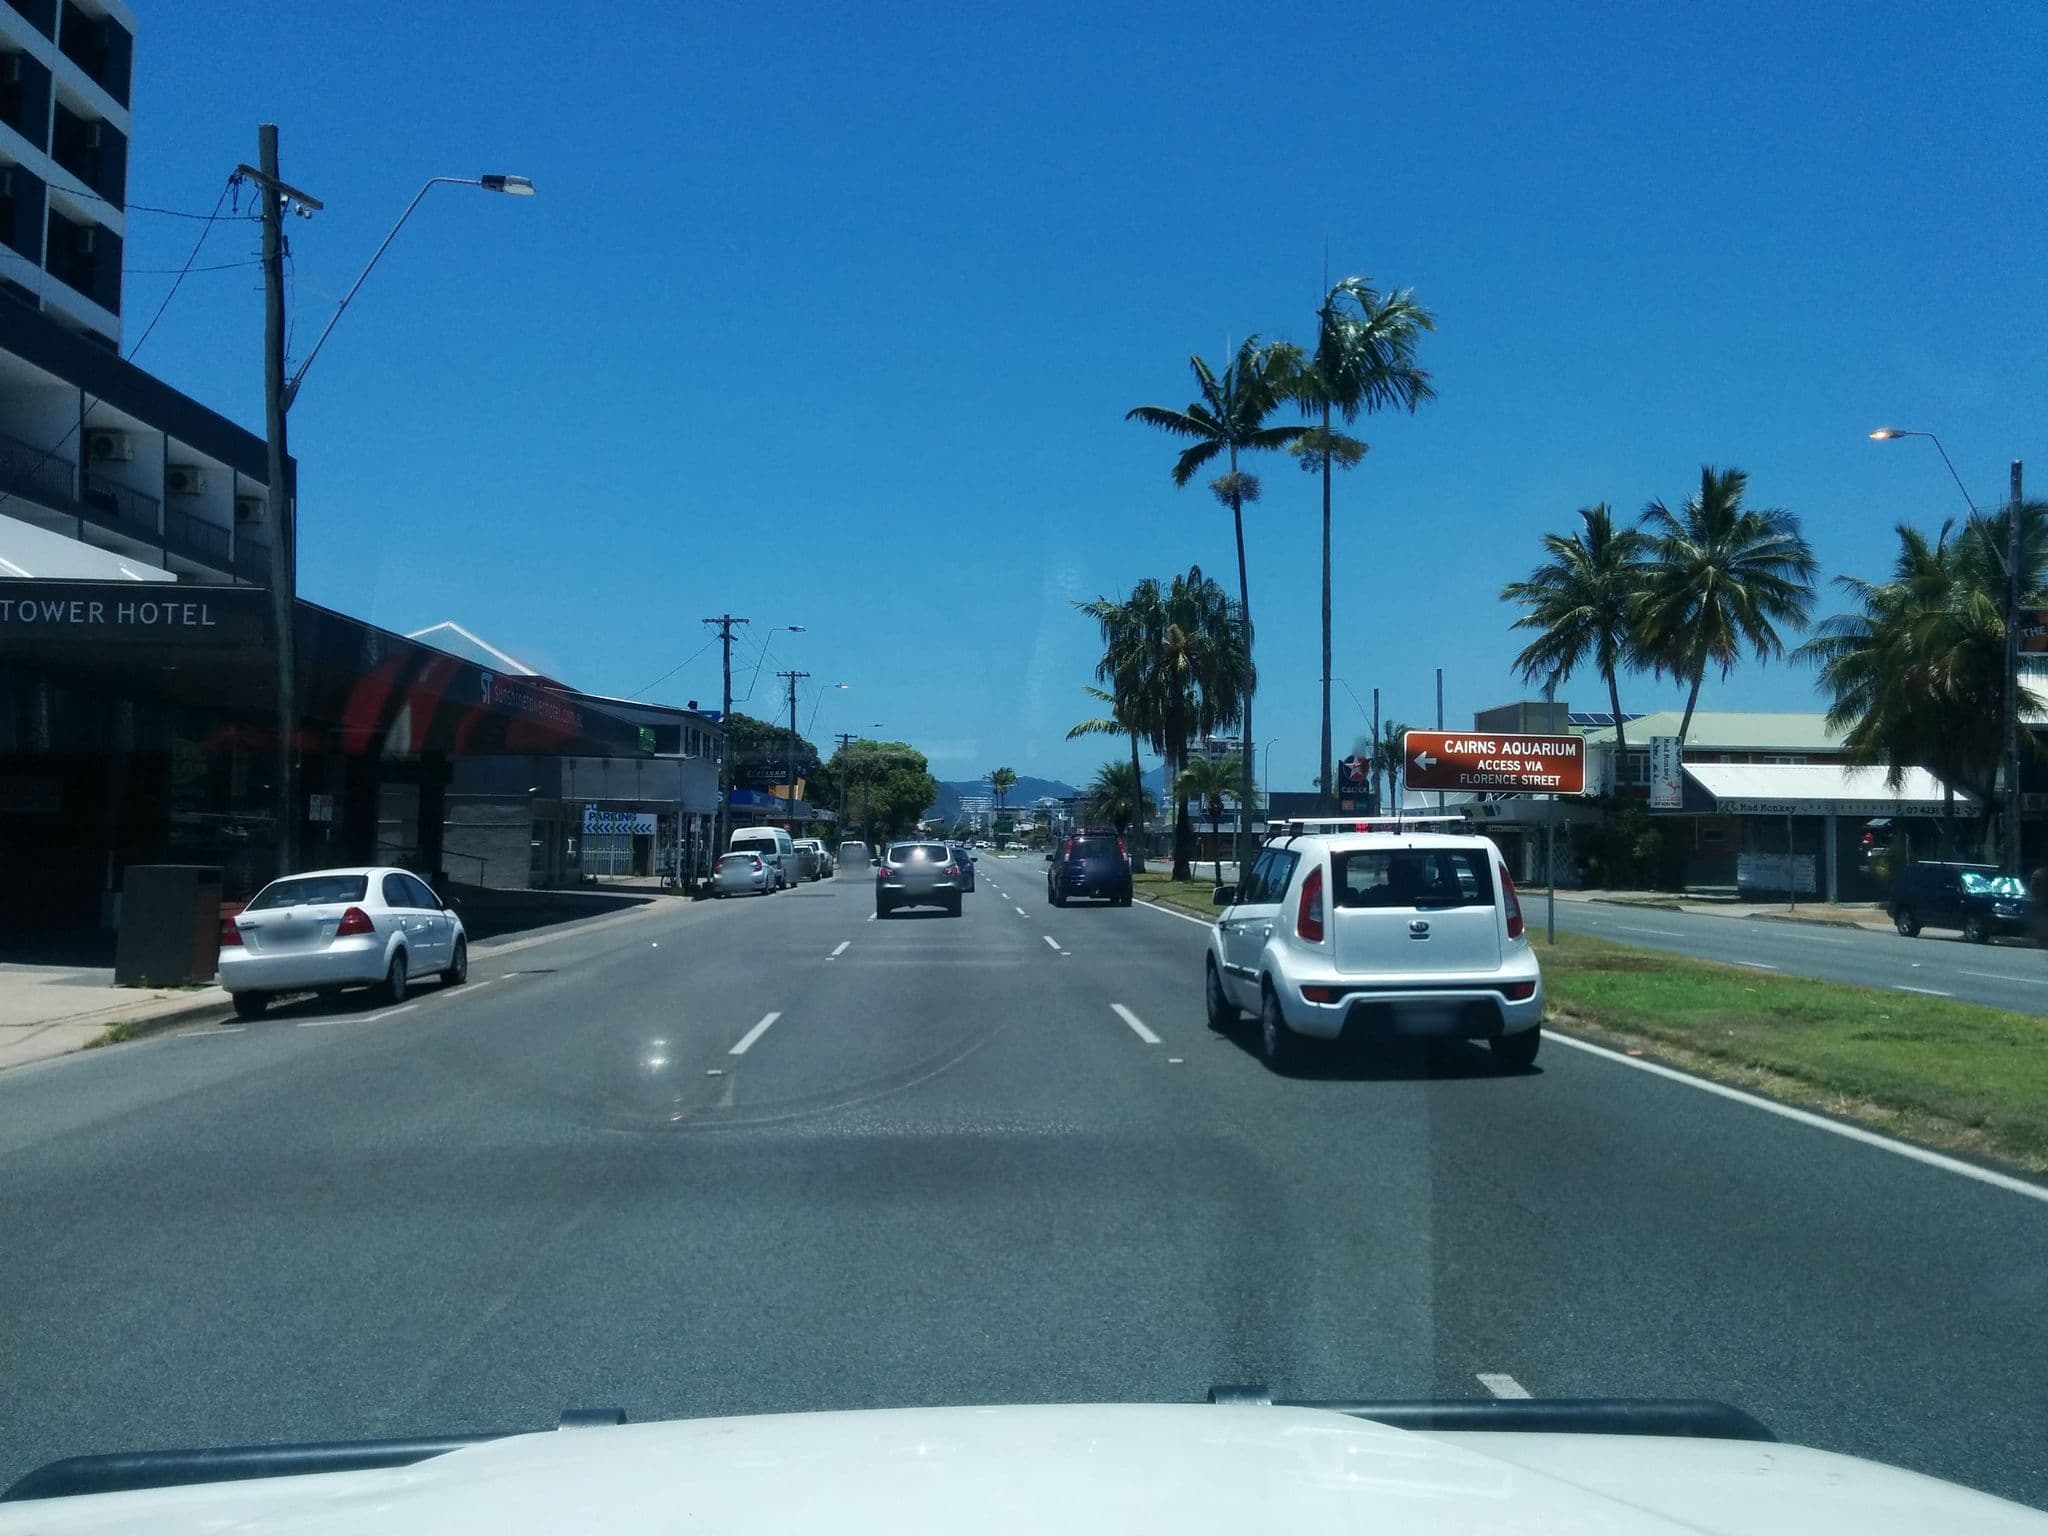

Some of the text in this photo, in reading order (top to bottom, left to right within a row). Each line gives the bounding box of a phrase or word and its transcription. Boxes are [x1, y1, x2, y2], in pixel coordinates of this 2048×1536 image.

[0, 600, 216, 625] TOWER HOTEL
[1444, 740, 1576, 756] CAIRNS AQUARIUM
[1477, 759, 1543, 772] ACCESS VIA
[1460, 773, 1561, 786] FLORENCE STREET
[1740, 803, 1758, 812] Mad
[1760, 803, 1797, 815] Monkey
[588, 811, 638, 822] PARKING
